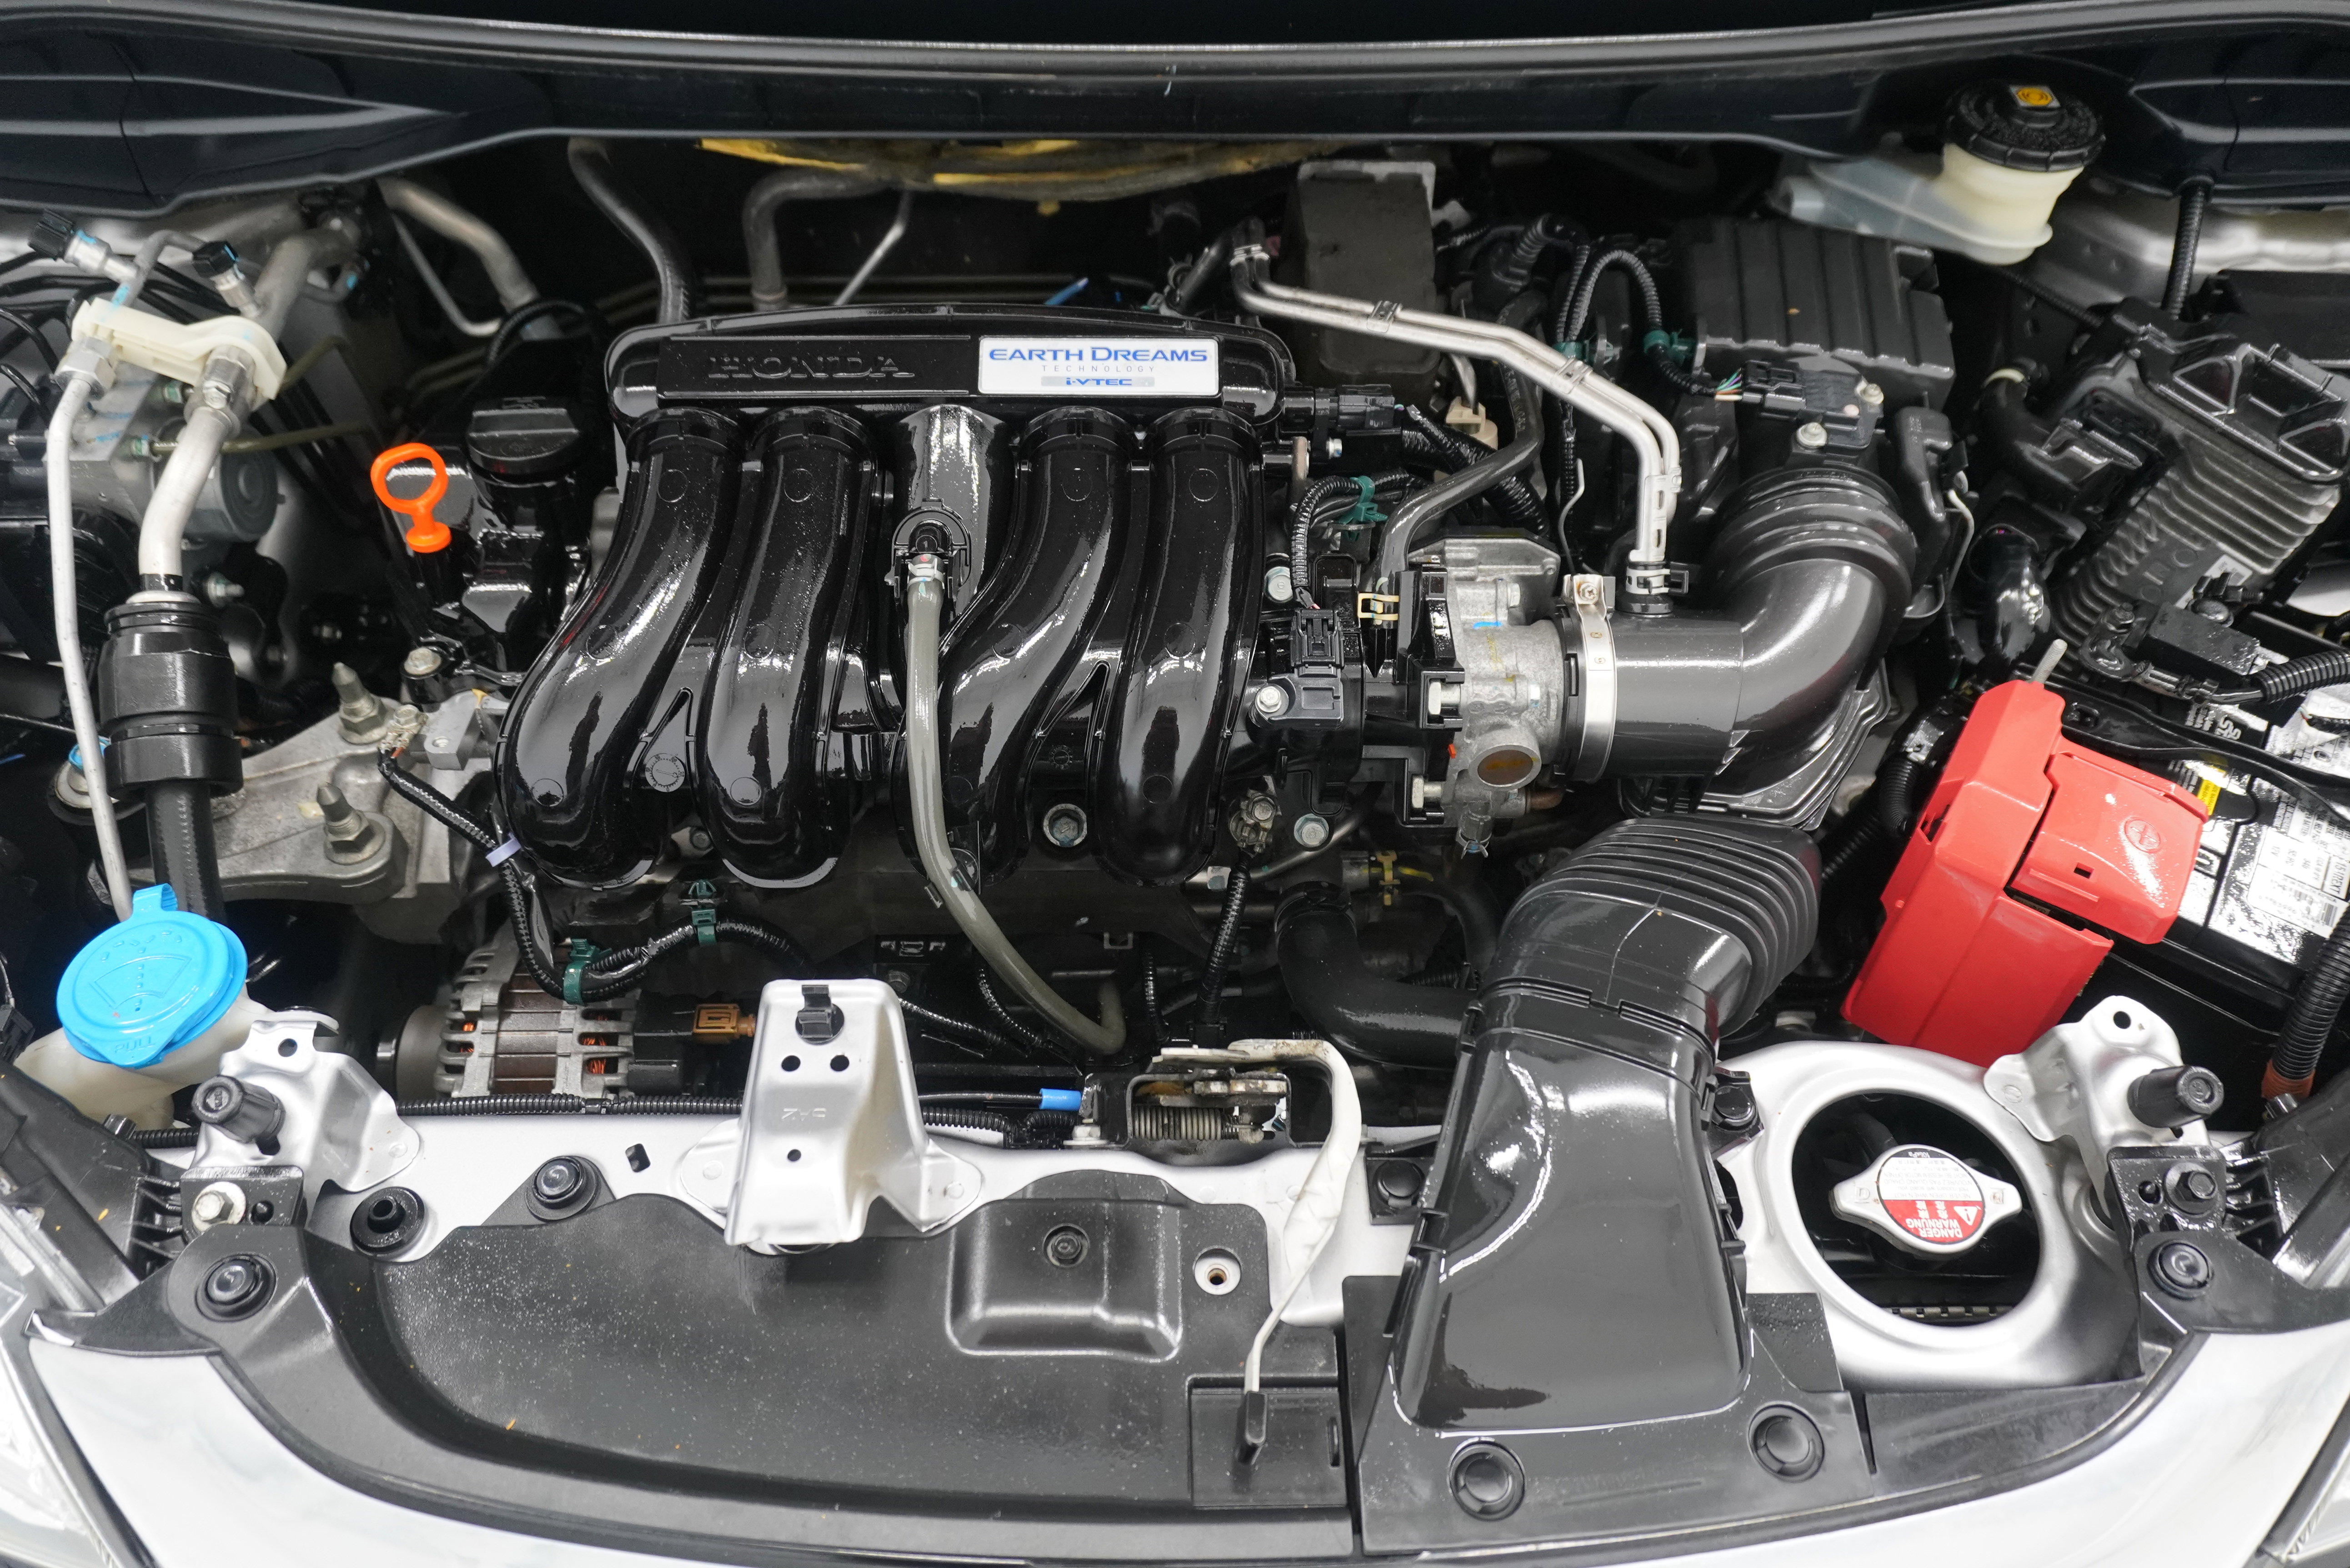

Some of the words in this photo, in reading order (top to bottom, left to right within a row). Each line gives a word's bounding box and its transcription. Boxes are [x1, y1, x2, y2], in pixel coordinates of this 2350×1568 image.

[989, 348, 1083, 361] EARTH
[1091, 347, 1208, 362] DREAMS
[1066, 377, 1132, 386] i-VTEC
[114, 1035, 156, 1054] PULL
[1906, 1218, 1961, 1229] WARNUNG
[1919, 1227, 1963, 1238] DANGER
